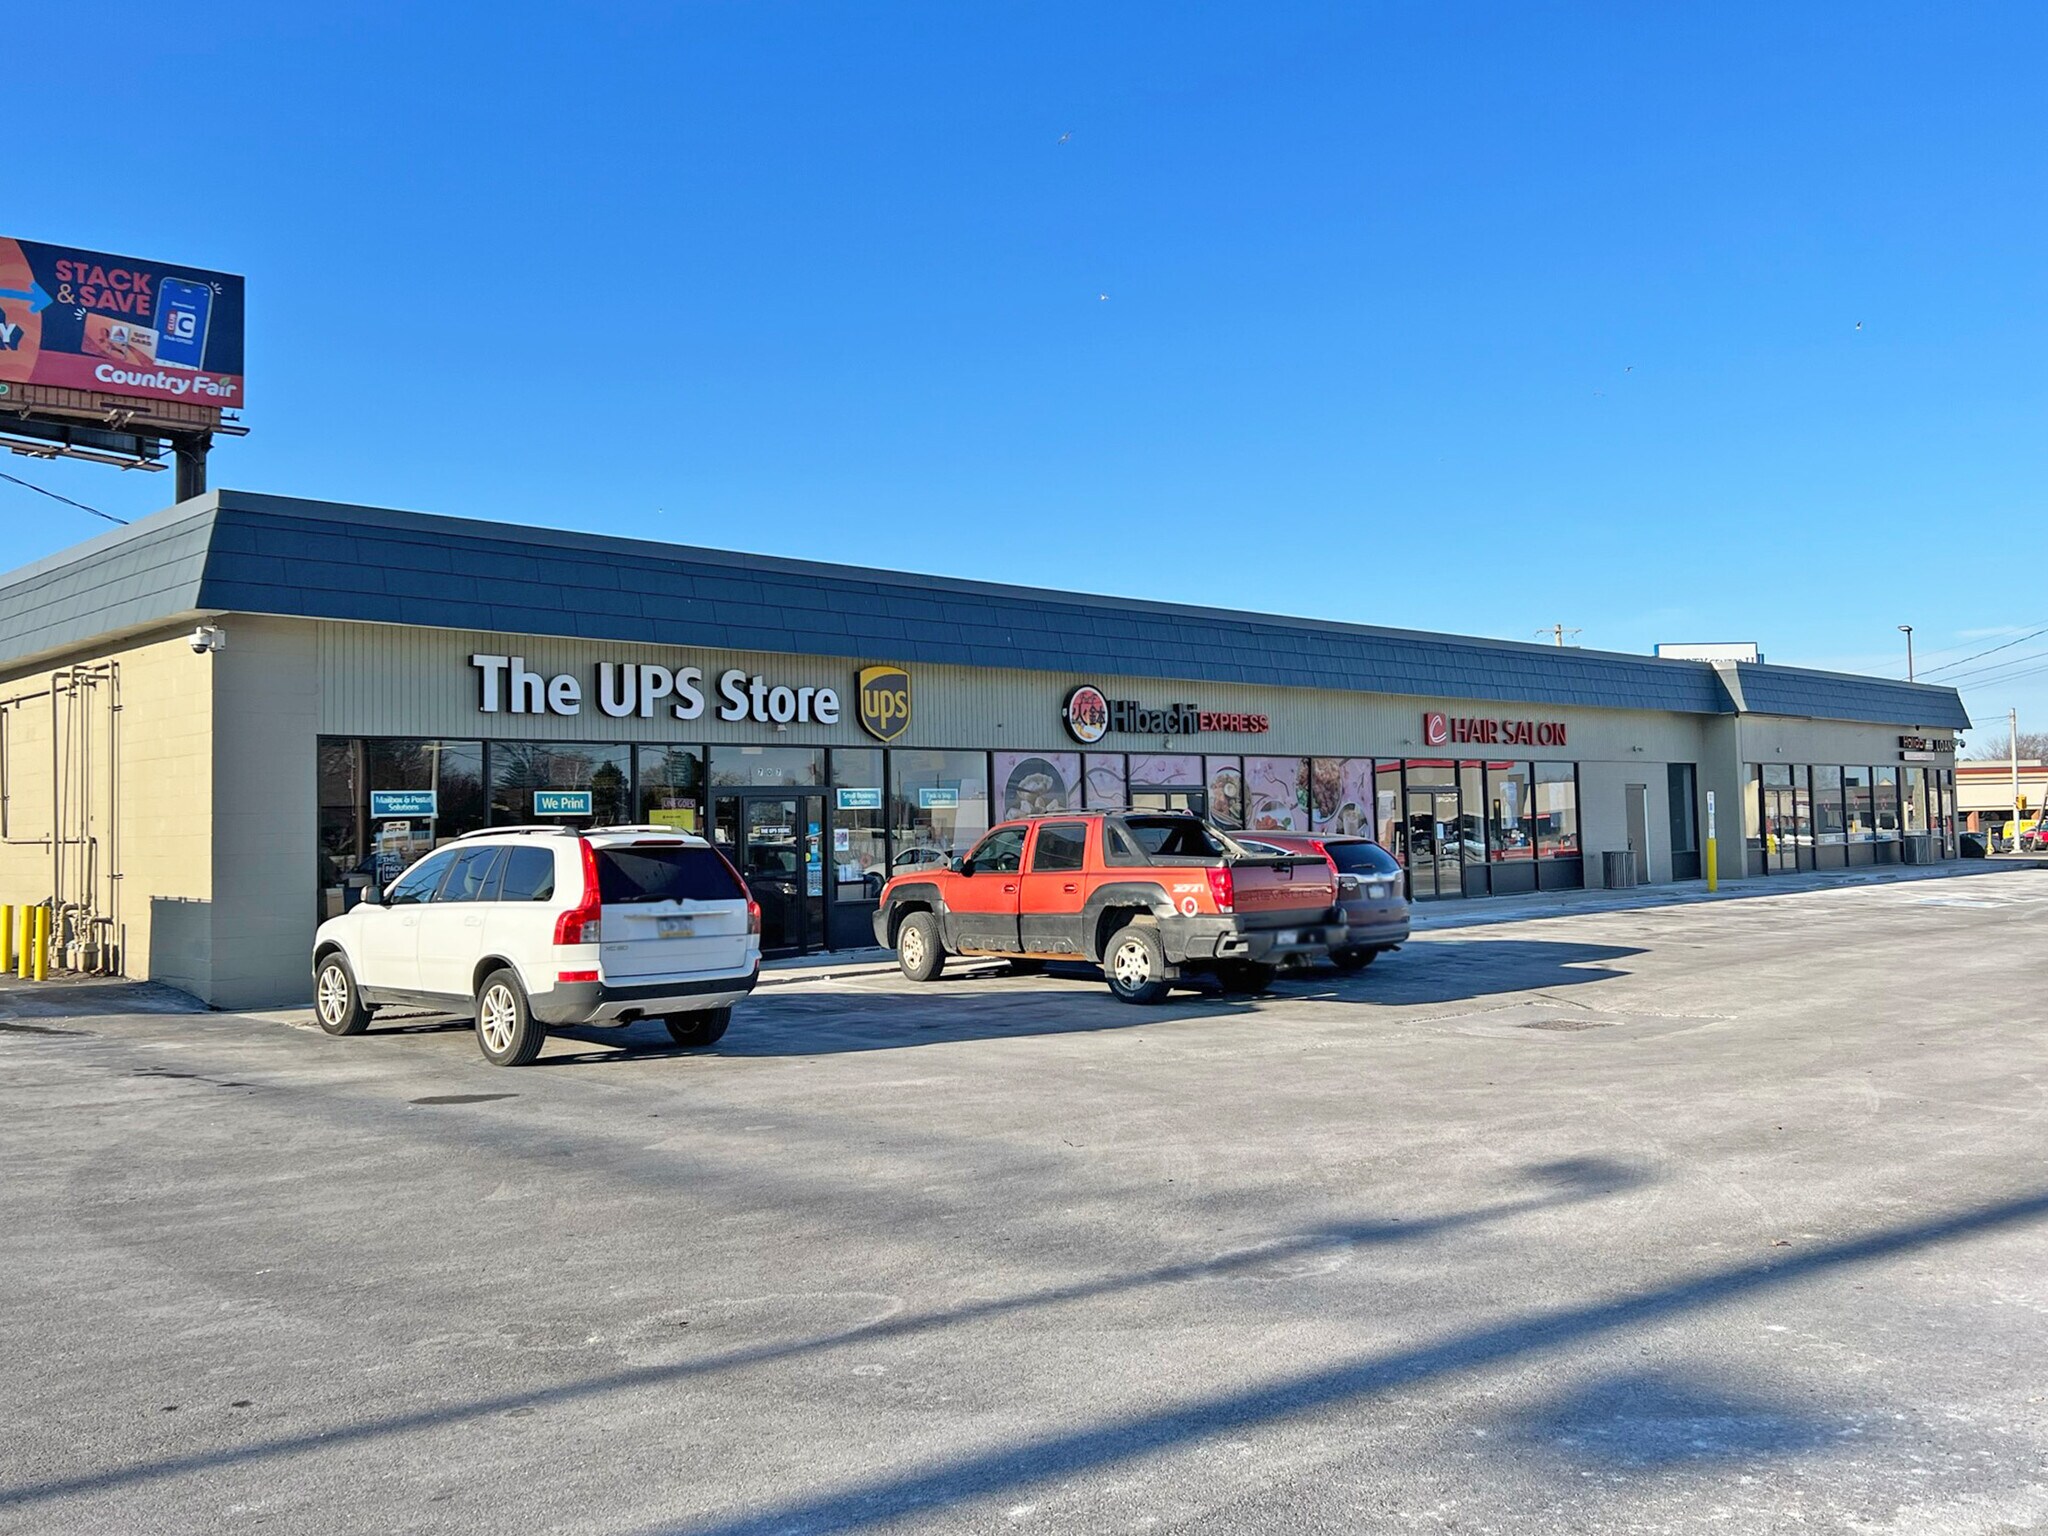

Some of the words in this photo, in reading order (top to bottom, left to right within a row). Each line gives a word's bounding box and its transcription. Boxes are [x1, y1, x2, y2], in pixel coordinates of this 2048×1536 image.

[55, 260, 152, 295] STACK
[57, 283, 75, 305] &
[79, 285, 150, 315] SAVE
[131, 337, 152, 346] CARD
[133, 332, 152, 340] GIFT
[95, 363, 191, 395] Country
[192, 376, 237, 397] Fair
[471, 653, 582, 716] The
[598, 661, 705, 720] UPS
[718, 669, 840, 724] Store
[864, 690, 908, 730] ups
[1109, 699, 1199, 734] Hibachi
[1200, 711, 1269, 732] EXPRESS
[1450, 717, 1498, 743] HAIR
[1502, 720, 1566, 745] SALON
[375, 795, 402, 804] Mailbox
[403, 796, 410, 804] &
[411, 795, 432, 804] Postal
[388, 803, 420, 811] Solutions
[541, 797, 558, 809] We
[561, 797, 584, 809] Print
